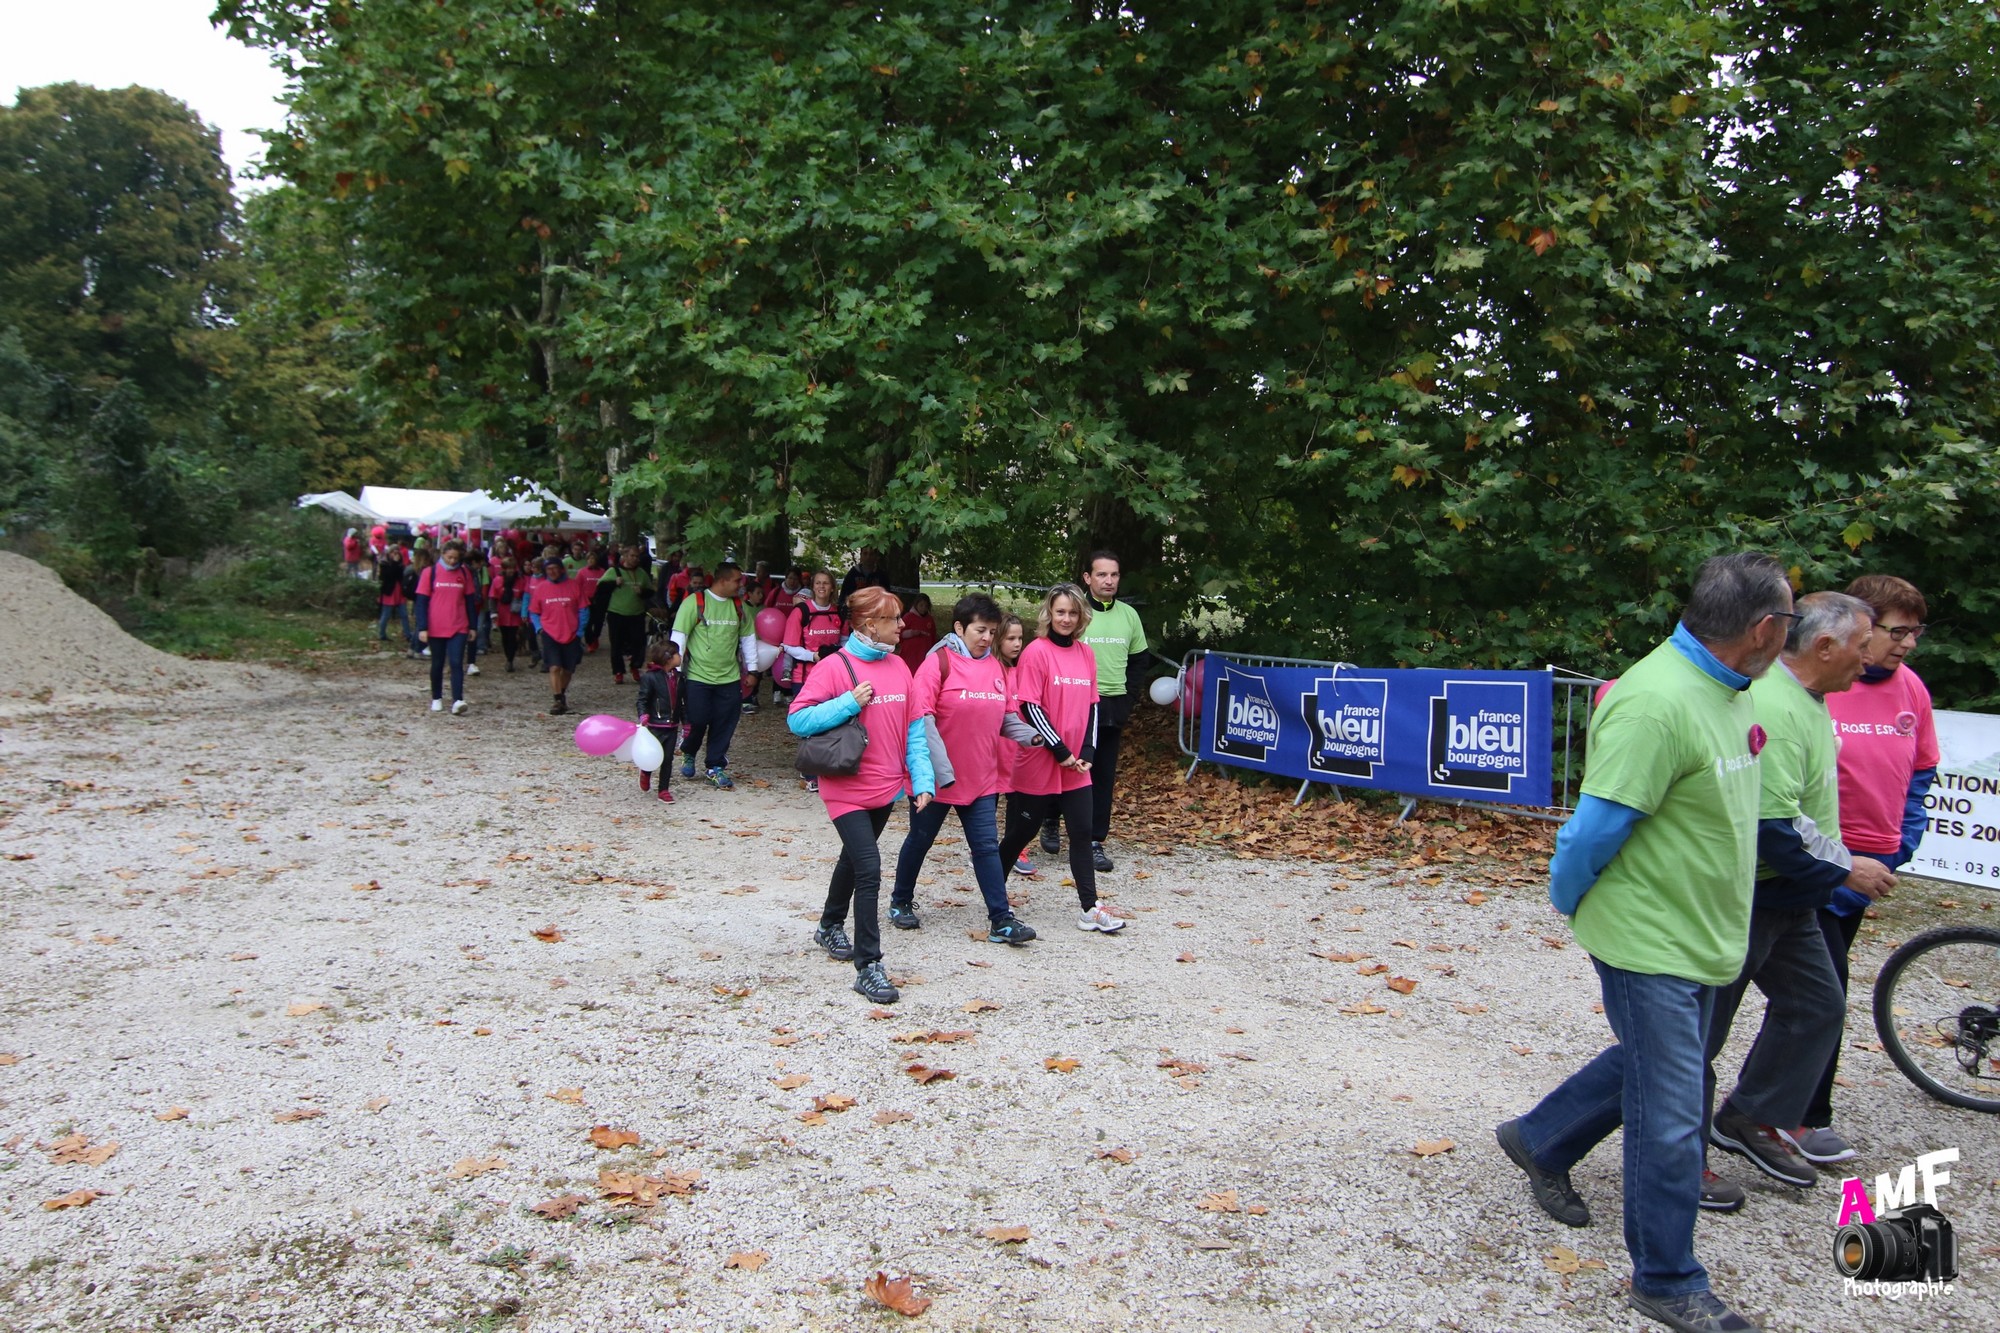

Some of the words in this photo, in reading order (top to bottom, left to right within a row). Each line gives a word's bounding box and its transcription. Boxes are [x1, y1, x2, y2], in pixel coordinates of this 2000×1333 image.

[1089, 636, 1105, 644] ROSE
[968, 691, 986, 700] ROSE
[1228, 694, 1277, 730] bleu
[1343, 703, 1380, 717] france
[1478, 709, 1521, 724] france
[1227, 723, 1275, 742] bourgogne
[1317, 709, 1380, 744] bleu
[1448, 715, 1521, 753] bleu
[1840, 722, 1872, 735] ROSE
[1324, 739, 1379, 758] bourgogne
[1447, 749, 1521, 769] bourgogne
[1931, 773, 2000, 795] ATION
[1930, 858, 1949, 869] TÉL
[1965, 861, 1984, 875] 03
